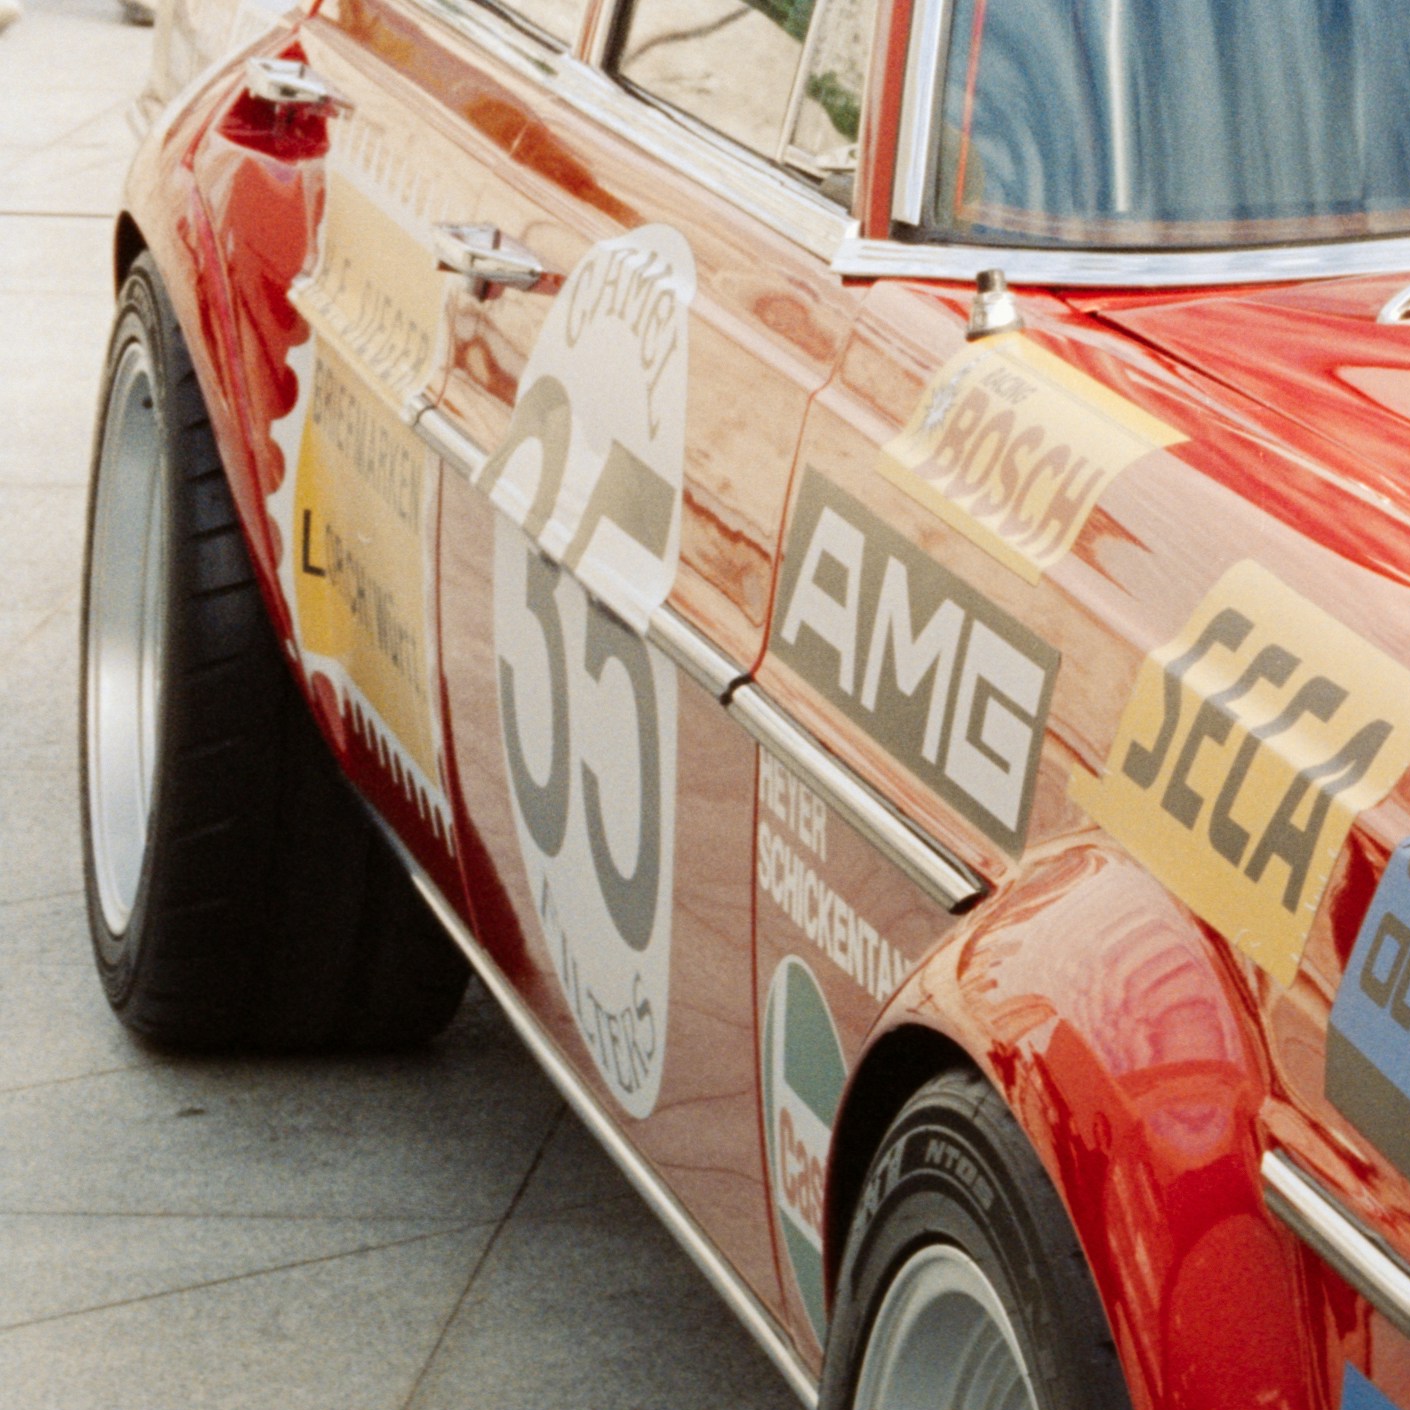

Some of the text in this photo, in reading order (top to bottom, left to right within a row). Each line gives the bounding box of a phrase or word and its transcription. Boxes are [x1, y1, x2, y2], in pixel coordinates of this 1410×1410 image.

[566, 248, 678, 441] CAMEL
[914, 387, 1106, 561] BOSCH
[476, 373, 677, 953] 35
[780, 505, 1047, 833] AMG
[1121, 607, 1394, 914] SECA
